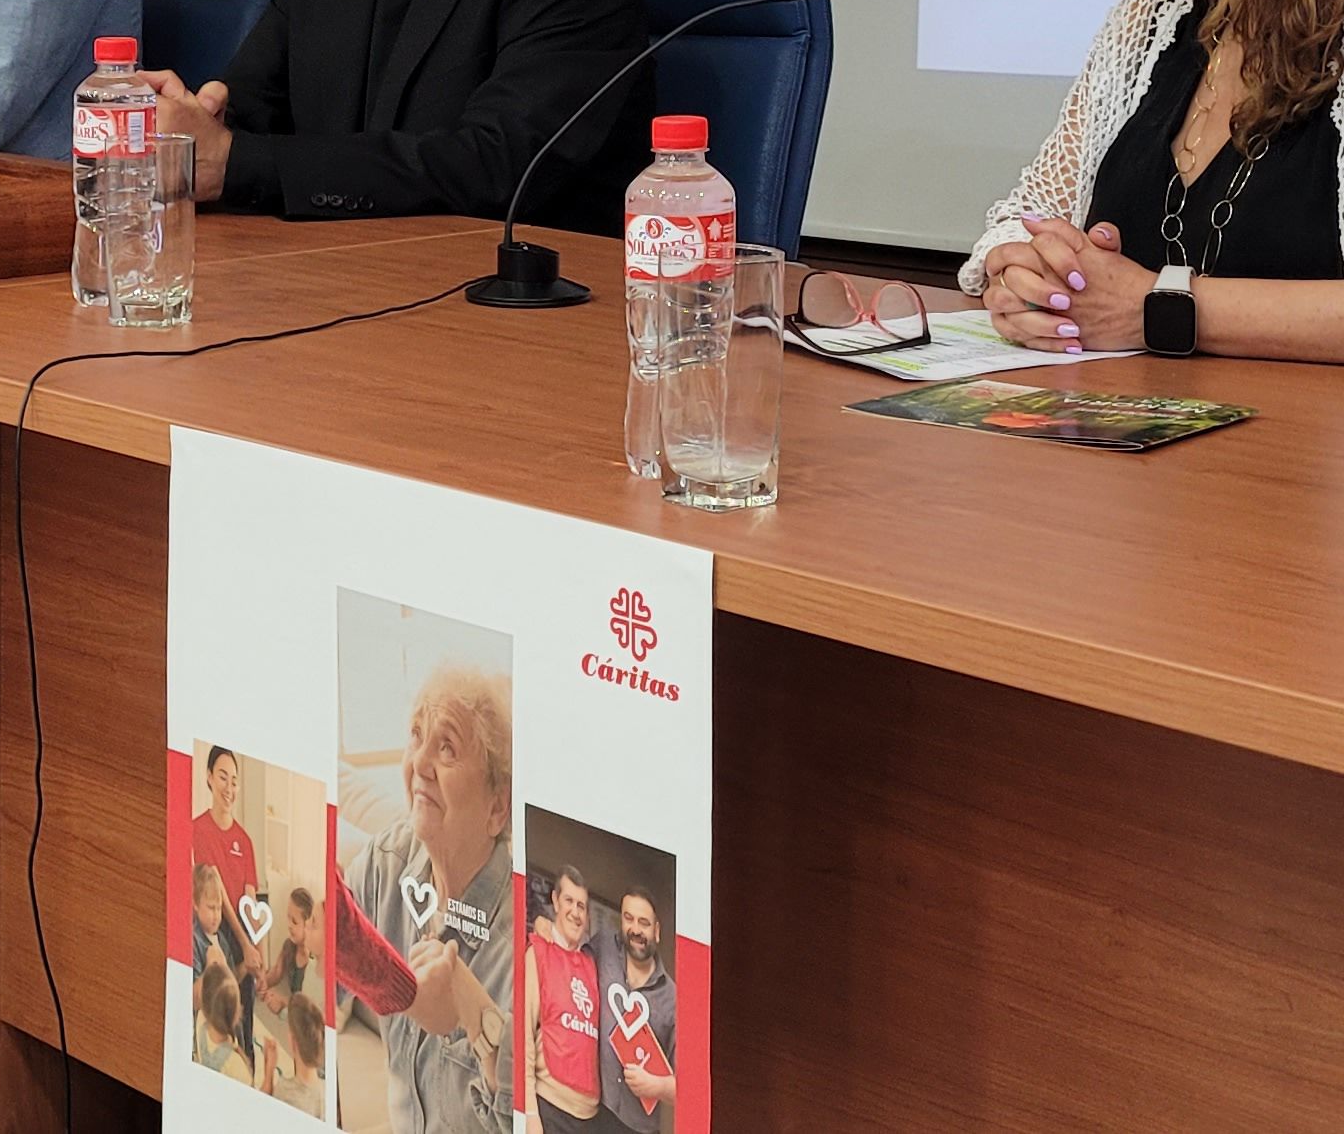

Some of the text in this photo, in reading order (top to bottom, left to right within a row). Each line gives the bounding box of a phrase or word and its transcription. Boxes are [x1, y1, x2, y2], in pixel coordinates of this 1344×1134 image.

[581, 653, 680, 702] Cáritas
[447, 897, 487, 925] ESTAMOS EN
[443, 913, 490, 942] CADA IMPULSO
